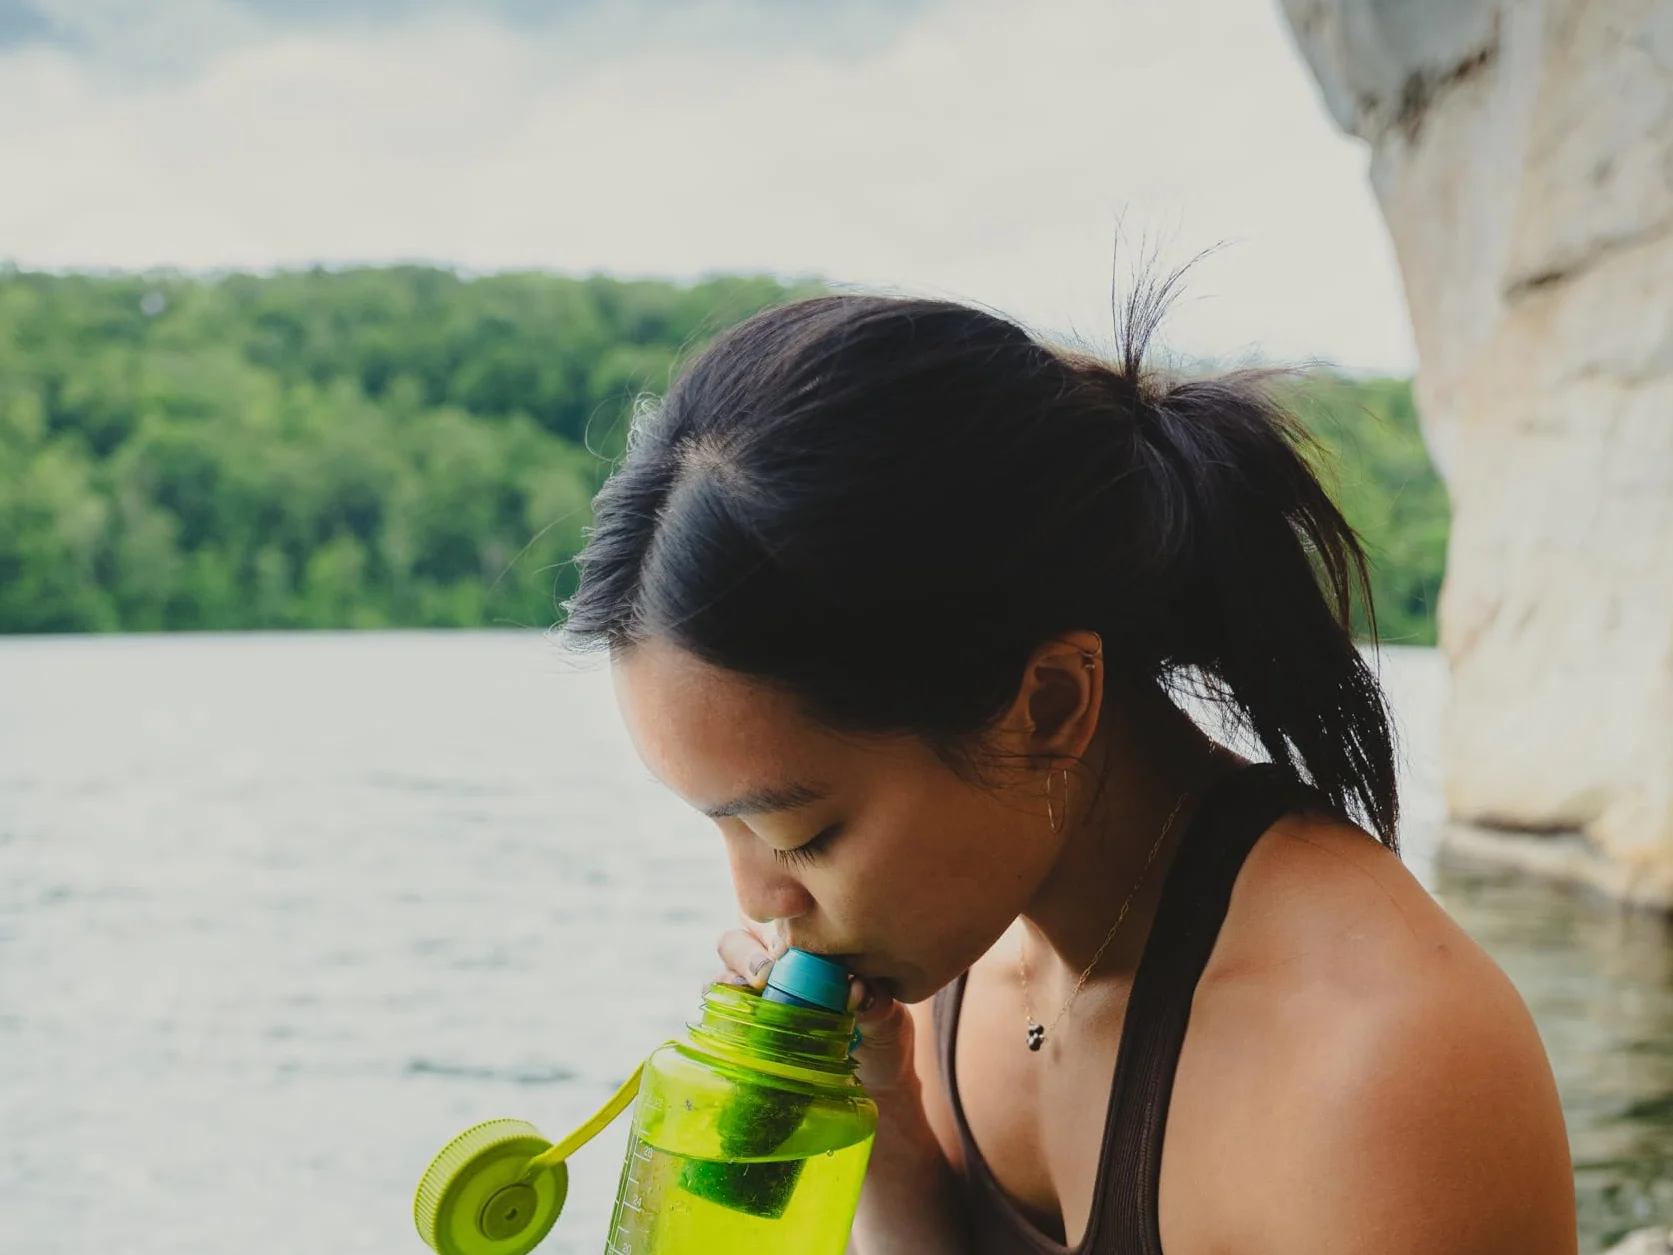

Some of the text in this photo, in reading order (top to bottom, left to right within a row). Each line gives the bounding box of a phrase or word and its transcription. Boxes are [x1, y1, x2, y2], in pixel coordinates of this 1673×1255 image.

[643, 1146, 654, 1159] 28
[632, 1196, 642, 1207] 24
[621, 1242, 632, 1255] 20
